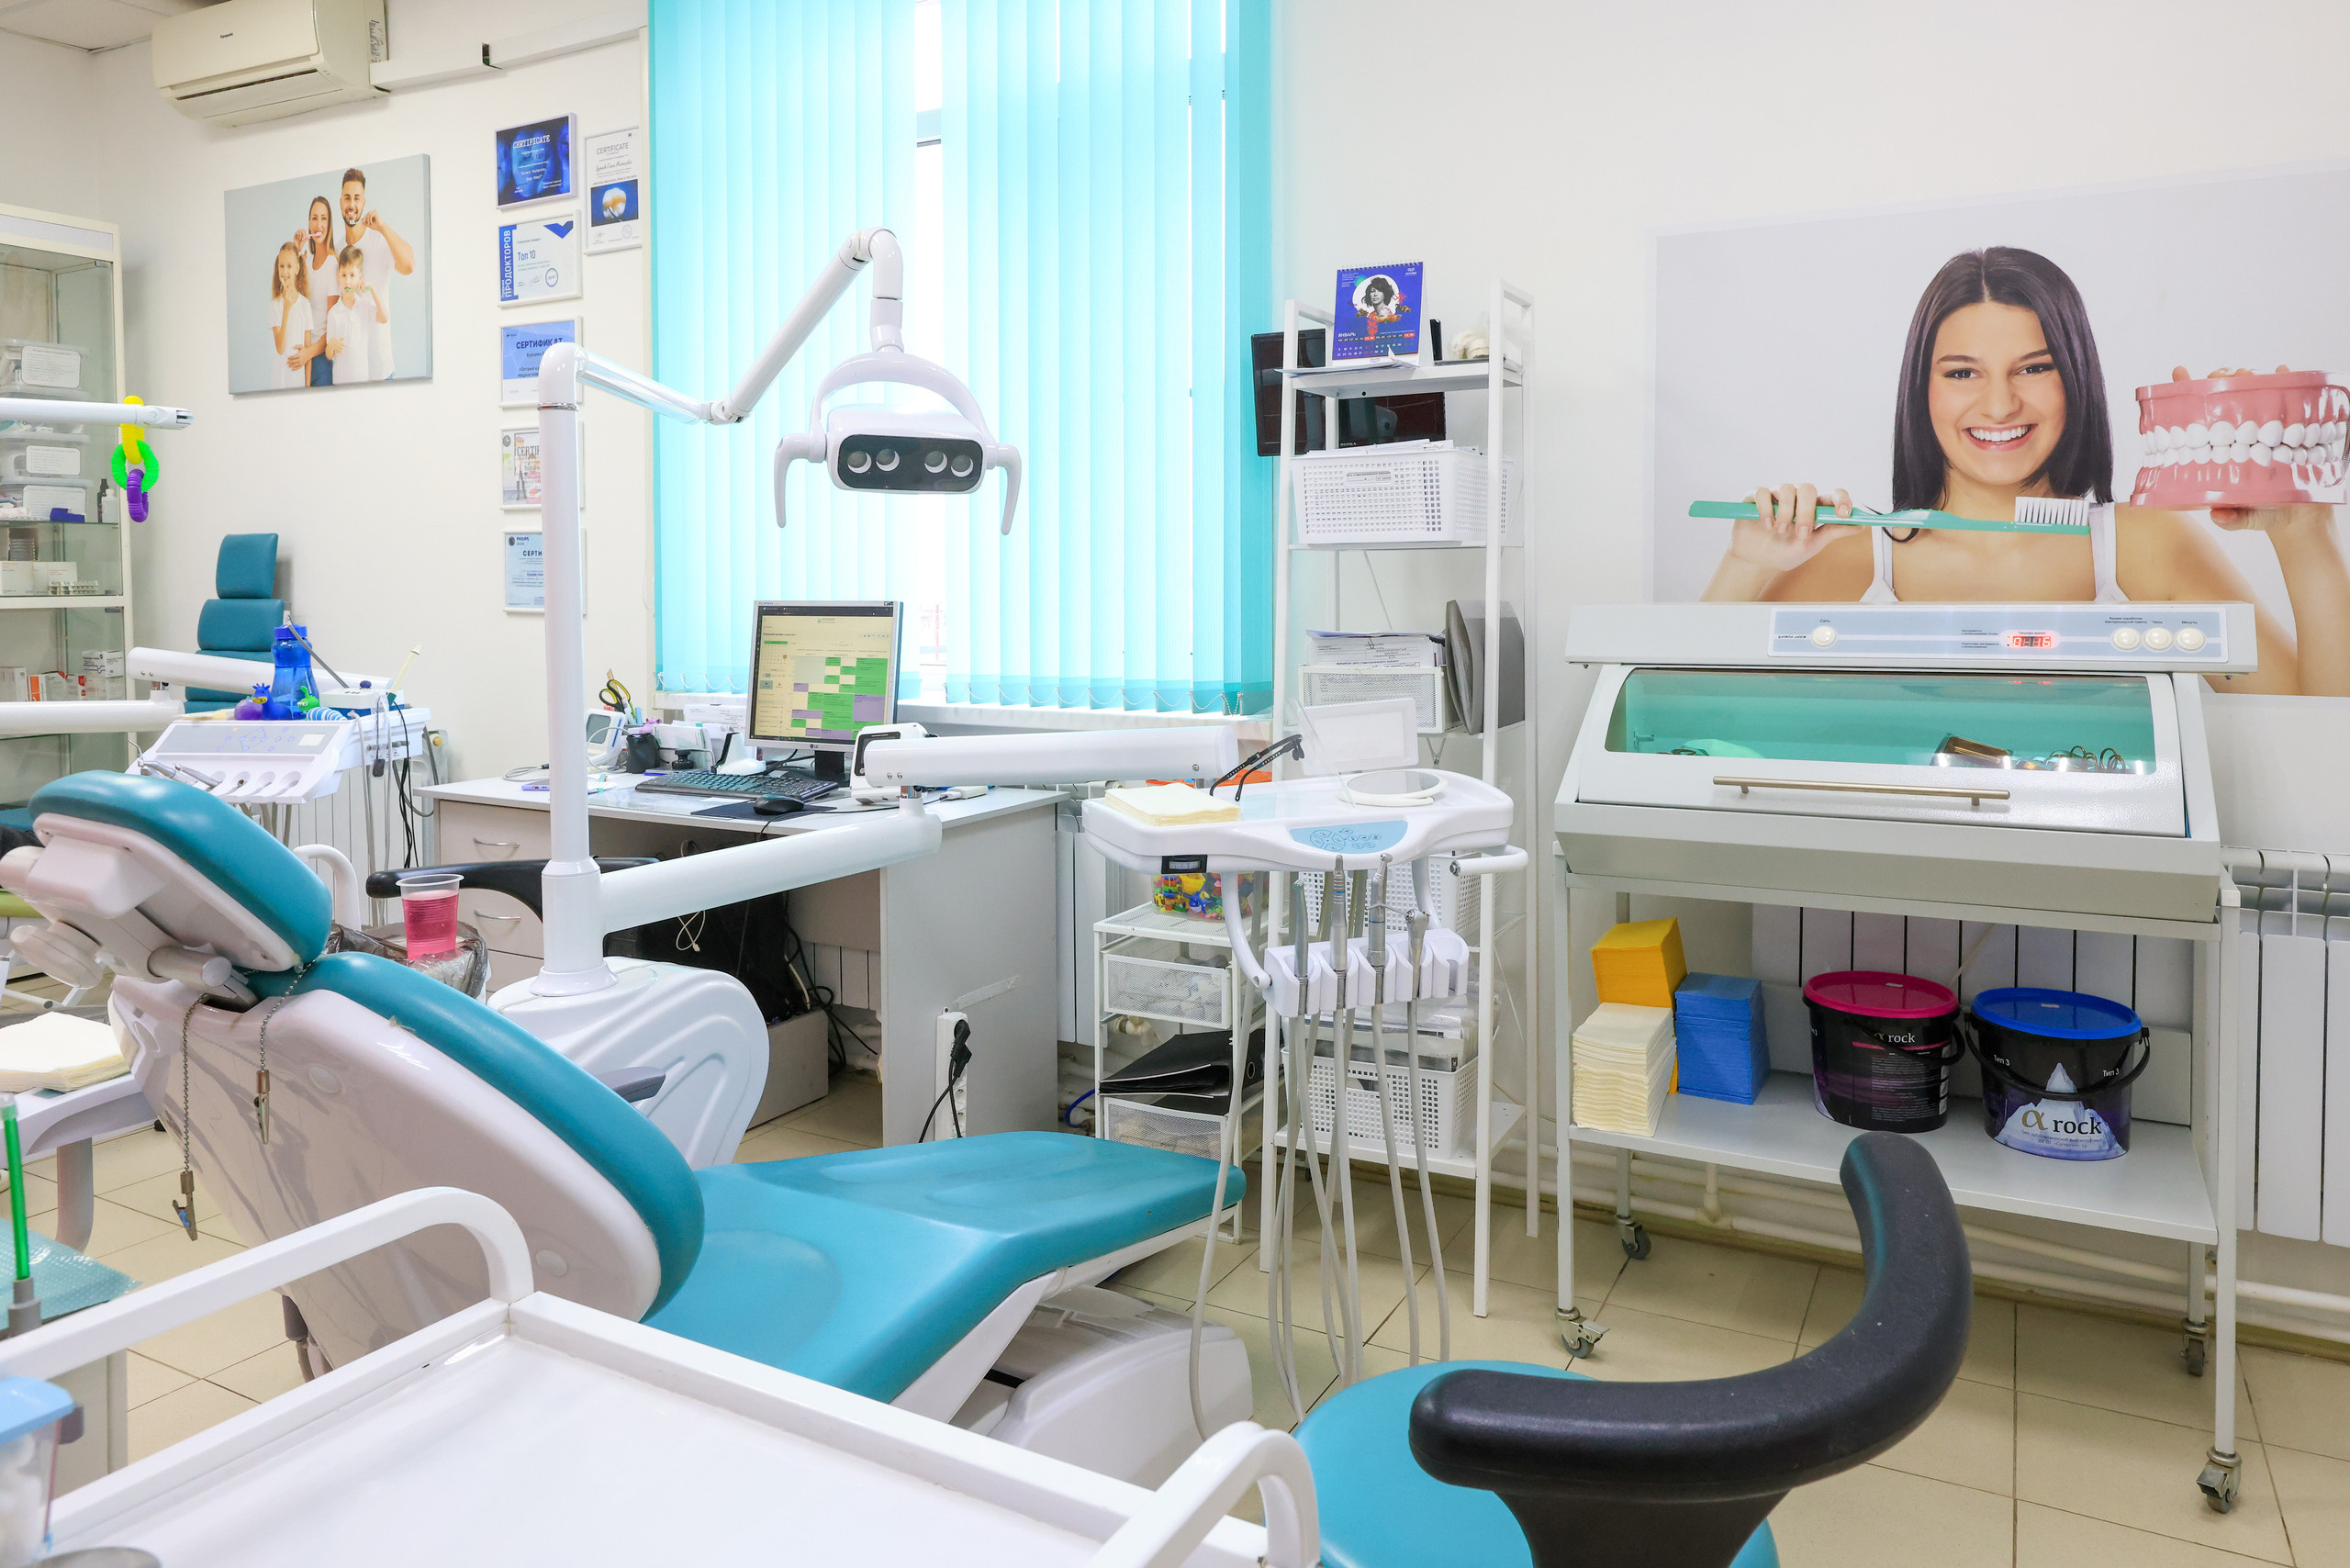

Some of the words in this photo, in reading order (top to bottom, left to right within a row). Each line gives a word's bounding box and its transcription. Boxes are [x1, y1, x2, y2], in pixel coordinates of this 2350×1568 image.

[513, 135, 551, 149] CERTIFICATE
[597, 142, 629, 154] CERTIFICATE
[518, 252, 528, 261] Топ
[530, 250, 536, 259] 10
[504, 230, 512, 297] ПРОДОКТОРОВ
[516, 338, 563, 349] СЕРТИФИКАТ
[1888, 1033, 1915, 1043] rock
[1994, 1055, 2004, 1064] Тип
[2053, 1117, 2102, 1134] rock
